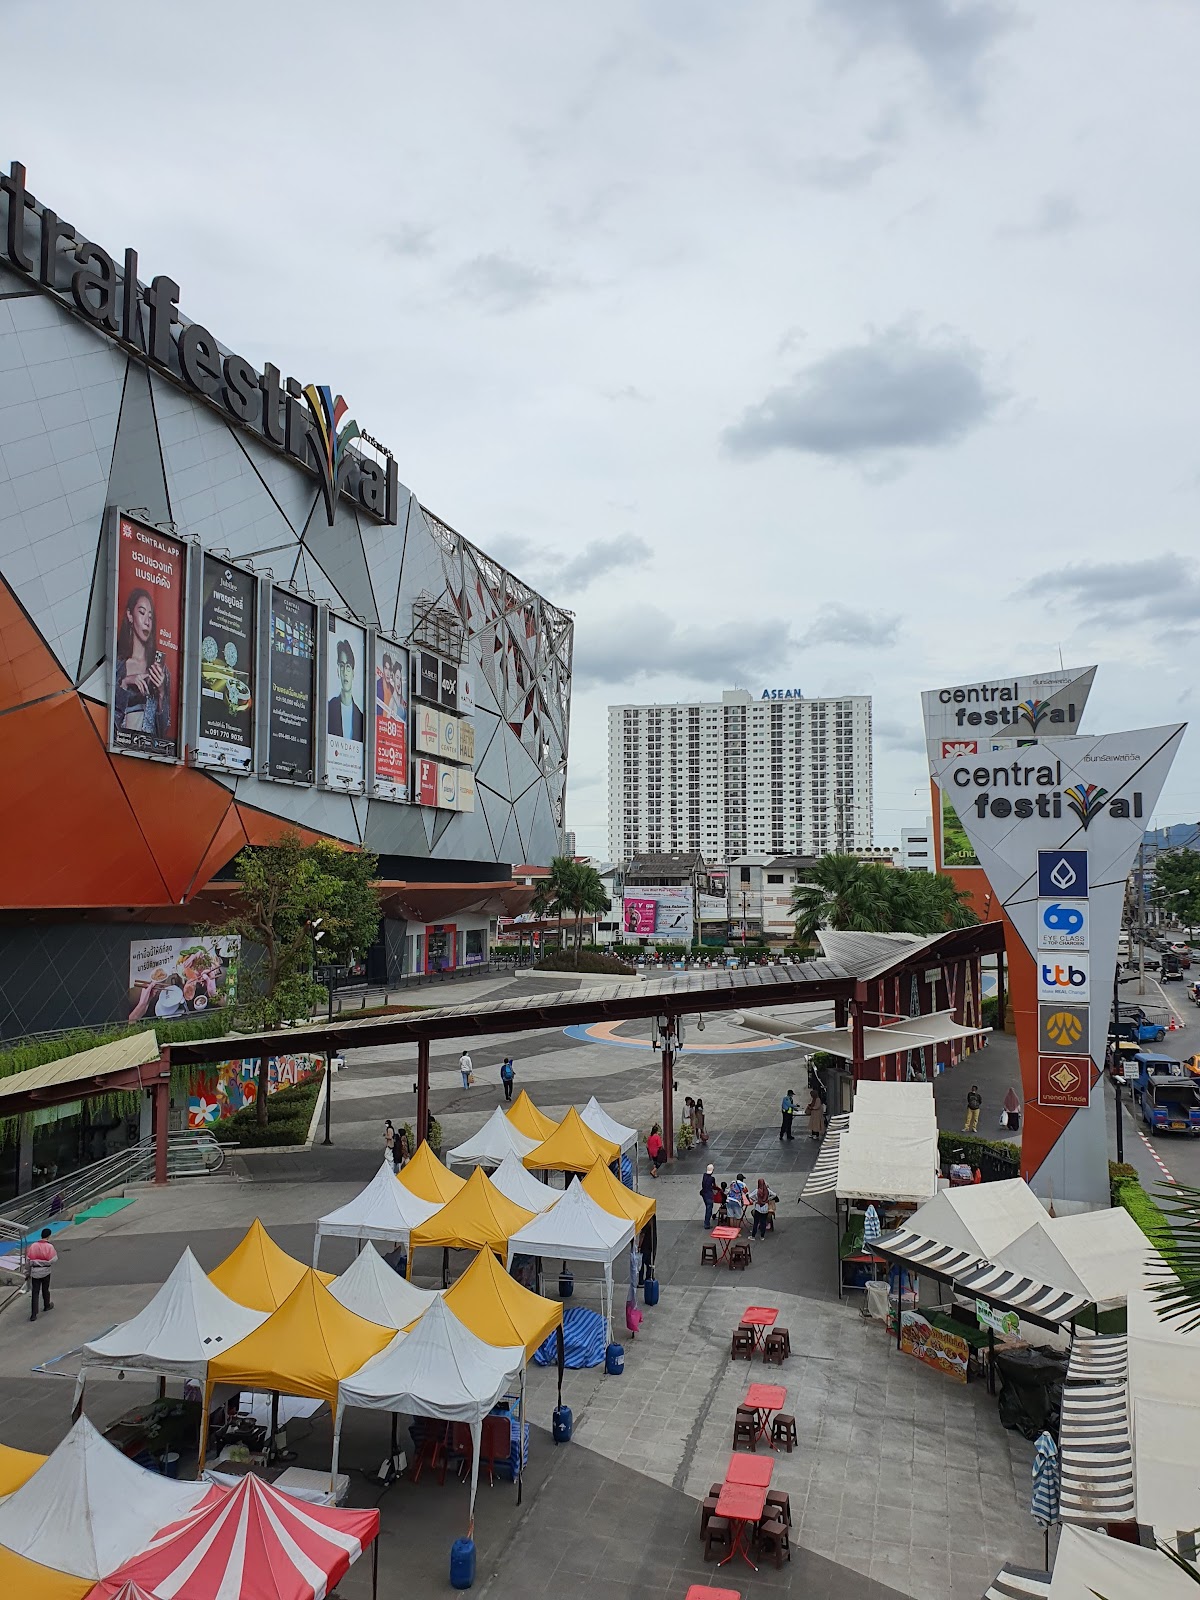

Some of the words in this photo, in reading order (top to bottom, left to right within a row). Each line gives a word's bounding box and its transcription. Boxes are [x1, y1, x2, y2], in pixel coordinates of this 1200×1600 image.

[136, 532, 167, 552] CENTRAL
[167, 546, 180, 557] APP
[220, 577, 238, 592] Jubilee
[761, 688, 801, 700] ASEAN
[939, 682, 1018, 703] central
[955, 700, 1075, 733] festival
[210, 728, 219, 737] 091
[220, 730, 230, 739] 770
[330, 740, 360, 754] OWNDAYS
[441, 744, 457, 754] CENTER
[460, 745, 474, 759] HALL
[953, 761, 1061, 787] central
[975, 784, 1143, 832] festival
[1042, 965, 1086, 987] ttb
